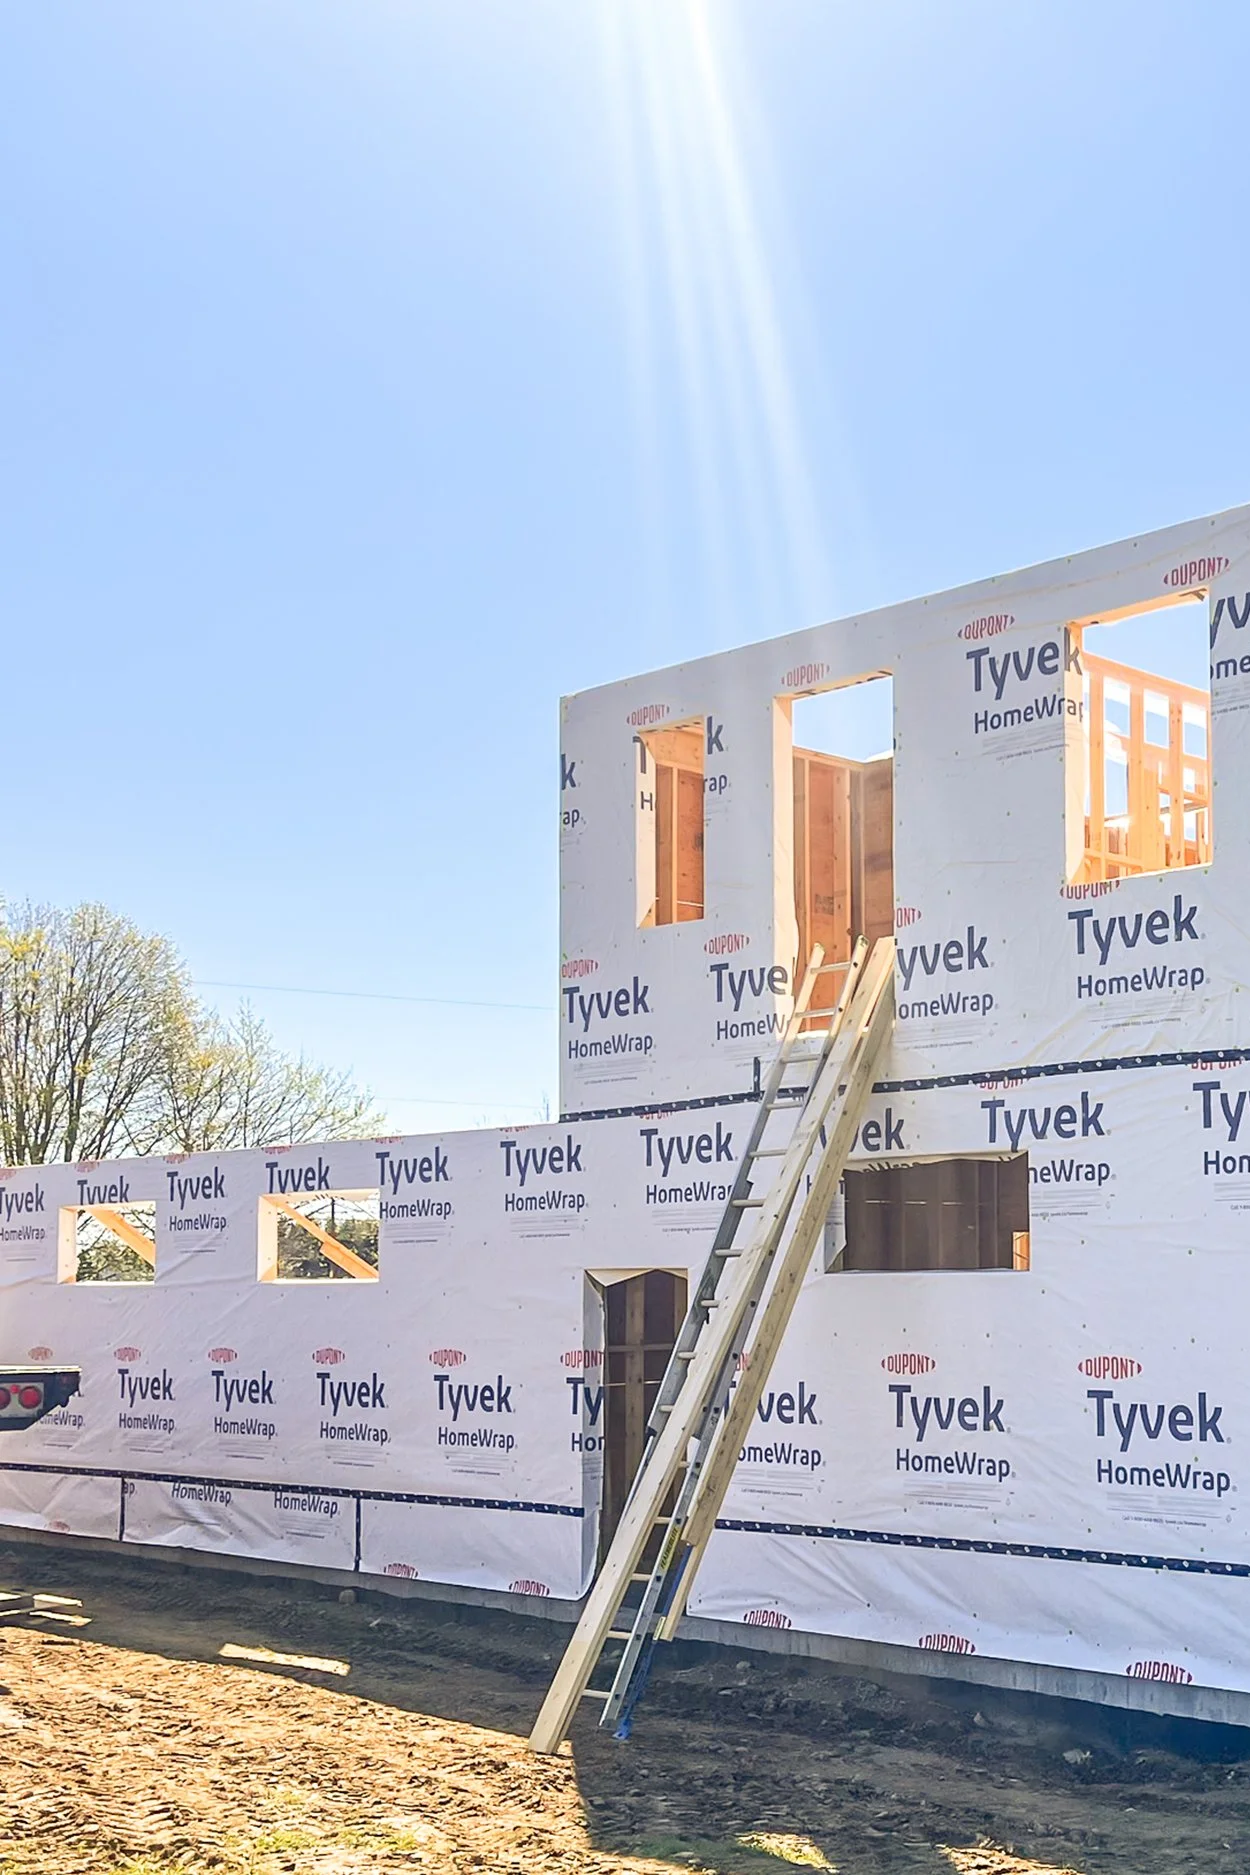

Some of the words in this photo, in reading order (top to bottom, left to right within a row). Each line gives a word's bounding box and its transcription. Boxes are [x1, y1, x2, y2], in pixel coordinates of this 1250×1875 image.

[1171, 557, 1222, 586] DUPONT
[964, 615, 1009, 640] DUPONT
[786, 662, 825, 687] DUPONT
[966, 626, 1083, 700] Tyvek
[708, 934, 745, 955] DUPONT
[1067, 895, 1199, 965] Tyvek
[895, 926, 989, 991] yvek
[710, 963, 787, 1011] Tyve
[1077, 966, 1204, 999] HomeWrap
[562, 976, 650, 1032] Tyvek
[895, 992, 994, 1019] omeWrap
[568, 1034, 653, 1059] HomeWrap
[981, 1091, 1105, 1152] Tyvek
[500, 1135, 582, 1186] Tyvek
[640, 1122, 734, 1177] Tyvek
[375, 1146, 450, 1194] Tyvek
[167, 1167, 226, 1209] Tyvek
[505, 1191, 585, 1213] HomeWrap
[169, 1214, 227, 1232] HomeWrap
[380, 1199, 452, 1219] HomeWrap
[887, 1353, 930, 1375] DUPONT
[1085, 1356, 1136, 1379] DUPONT
[117, 1368, 173, 1408] Tyvek
[212, 1370, 274, 1412] Tyvek
[317, 1372, 385, 1416] Tyvek
[433, 1375, 513, 1421] Tyvek
[119, 1413, 175, 1434] HomeWrap
[214, 1417, 276, 1437] HomeWrap
[888, 1385, 1005, 1442] Tyvek
[1087, 1389, 1224, 1452] Tyvek
[320, 1422, 389, 1445] HomeWrap
[438, 1427, 515, 1453] HomeWrap
[737, 1443, 822, 1471] omeWrap
[897, 1448, 1010, 1482] HomeWrap
[1097, 1459, 1230, 1497] HomeWrap
[274, 1491, 339, 1518] HomeWrap
